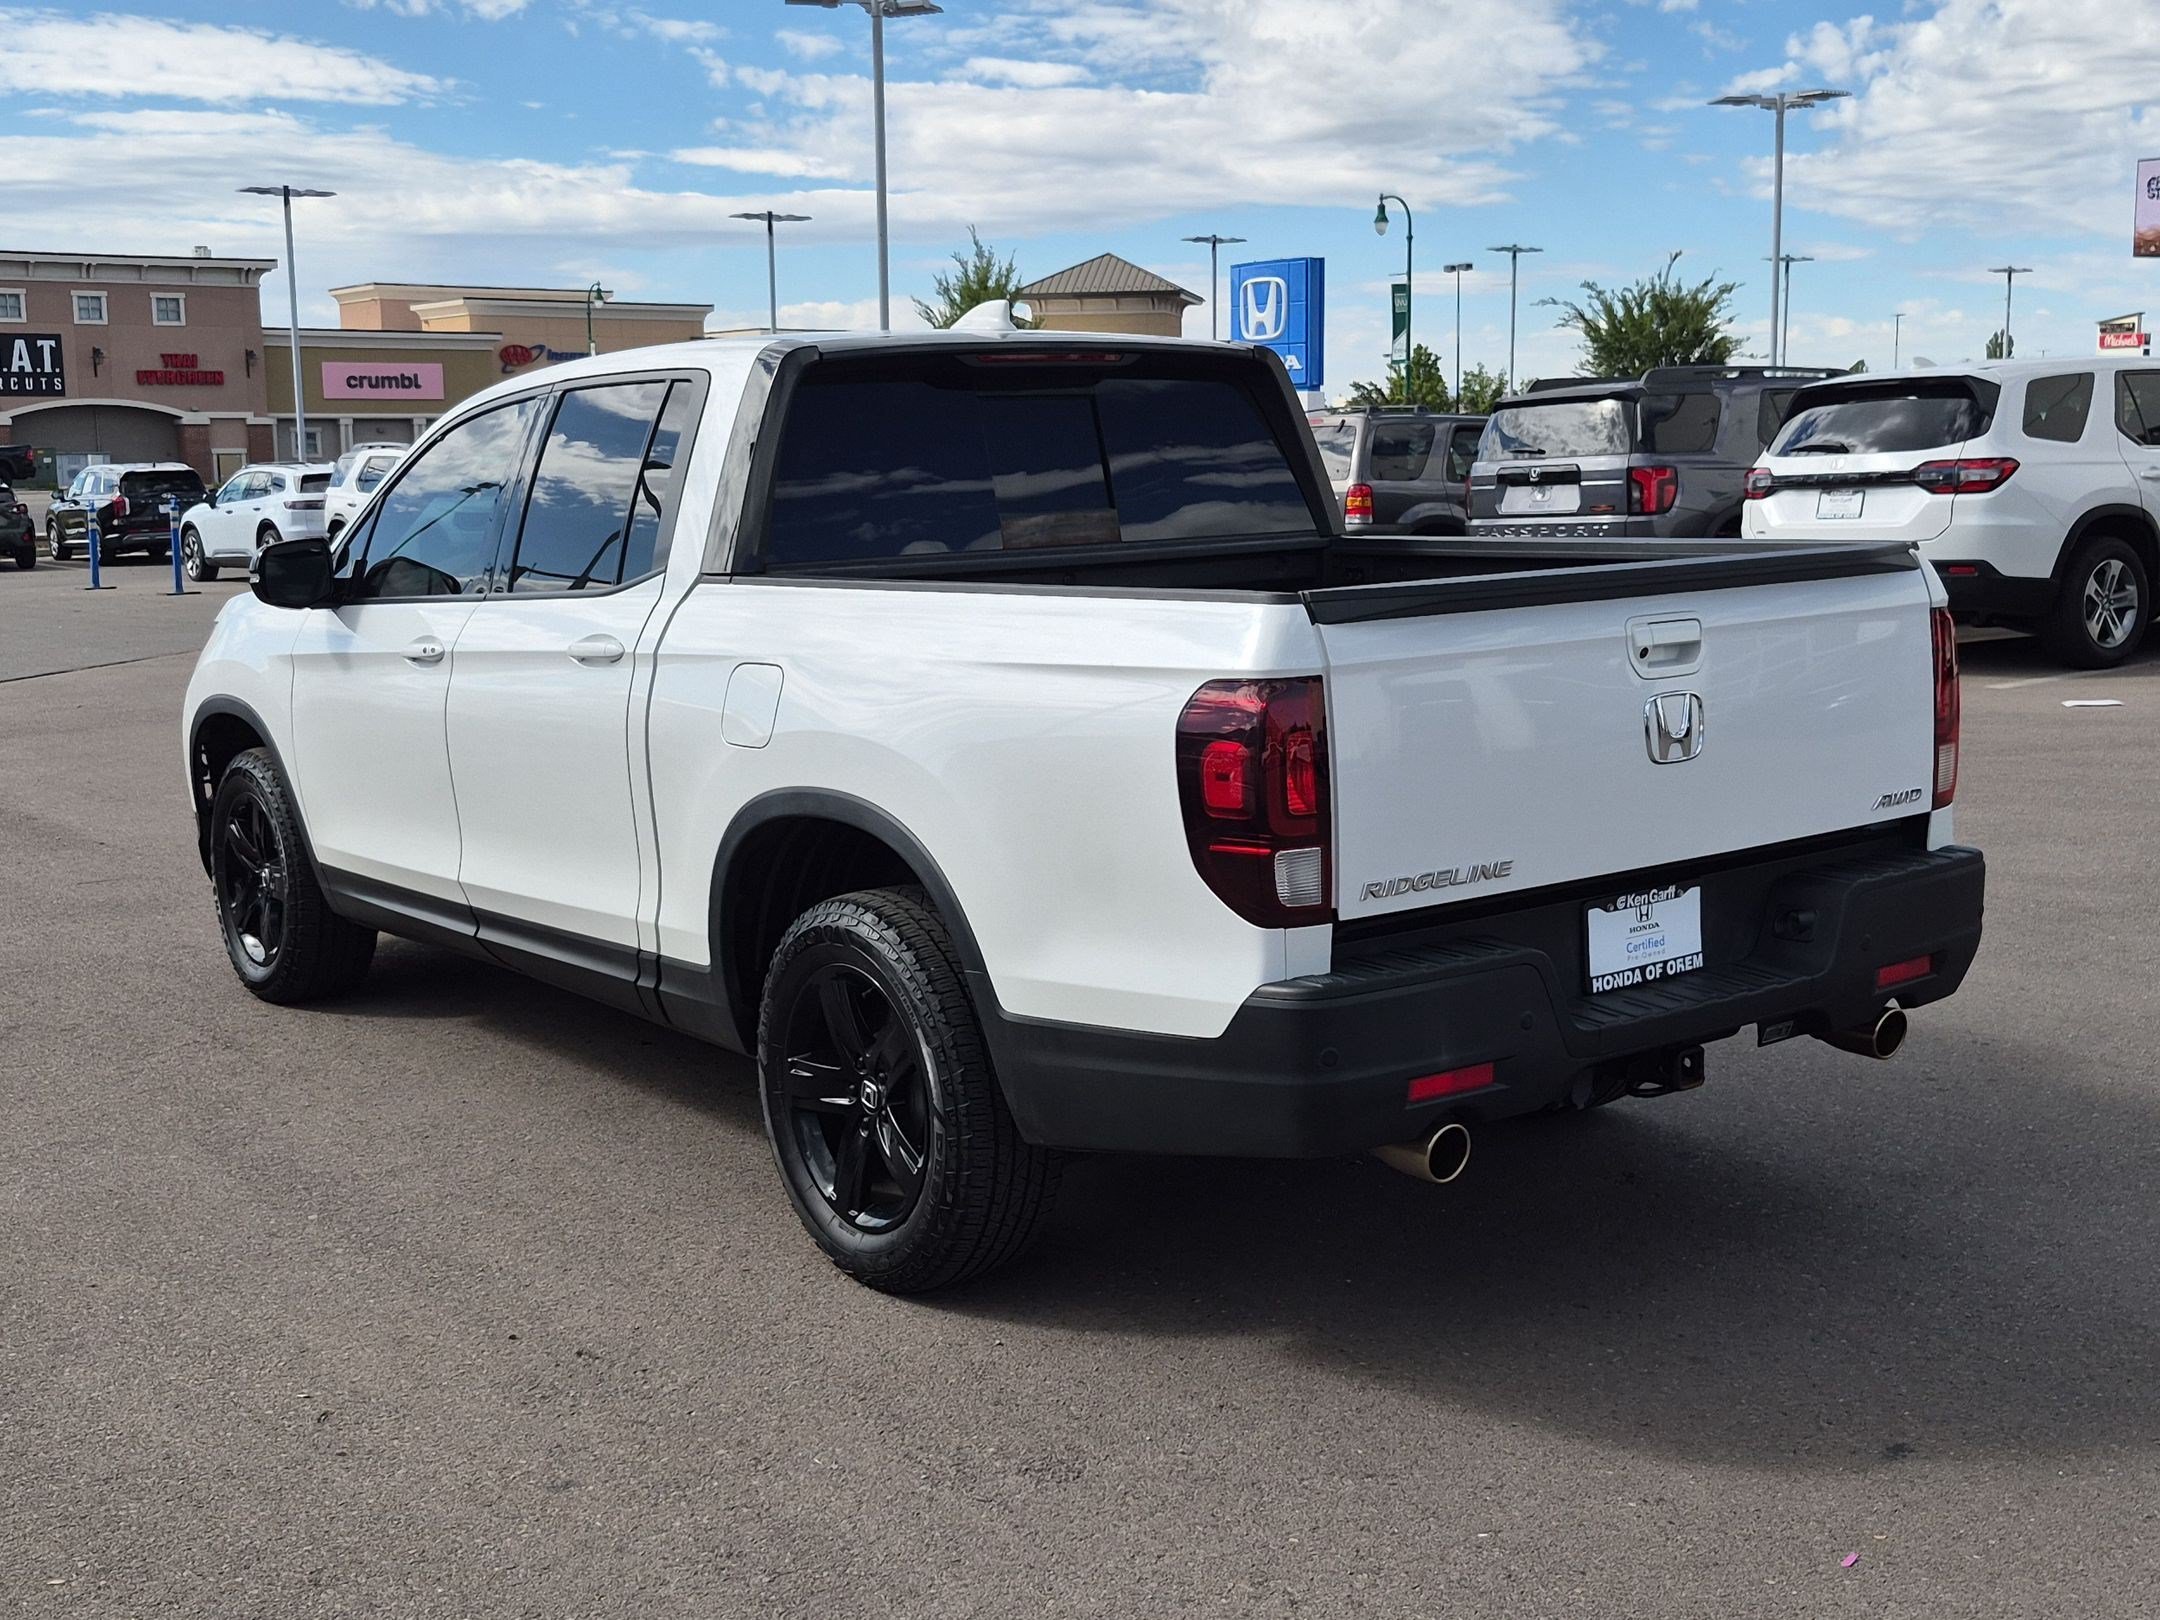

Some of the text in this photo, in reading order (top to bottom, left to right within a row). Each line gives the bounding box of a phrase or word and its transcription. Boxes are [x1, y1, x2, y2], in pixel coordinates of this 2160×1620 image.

[345, 373, 422, 390] crumbl
[1871, 787, 1922, 811] AWD
[1360, 860, 1514, 901] RIDGELINE
[1629, 922, 1660, 934] HONDA
[1626, 935, 1665, 954] Certified
[1592, 952, 1704, 994] HONDA OF OREM
